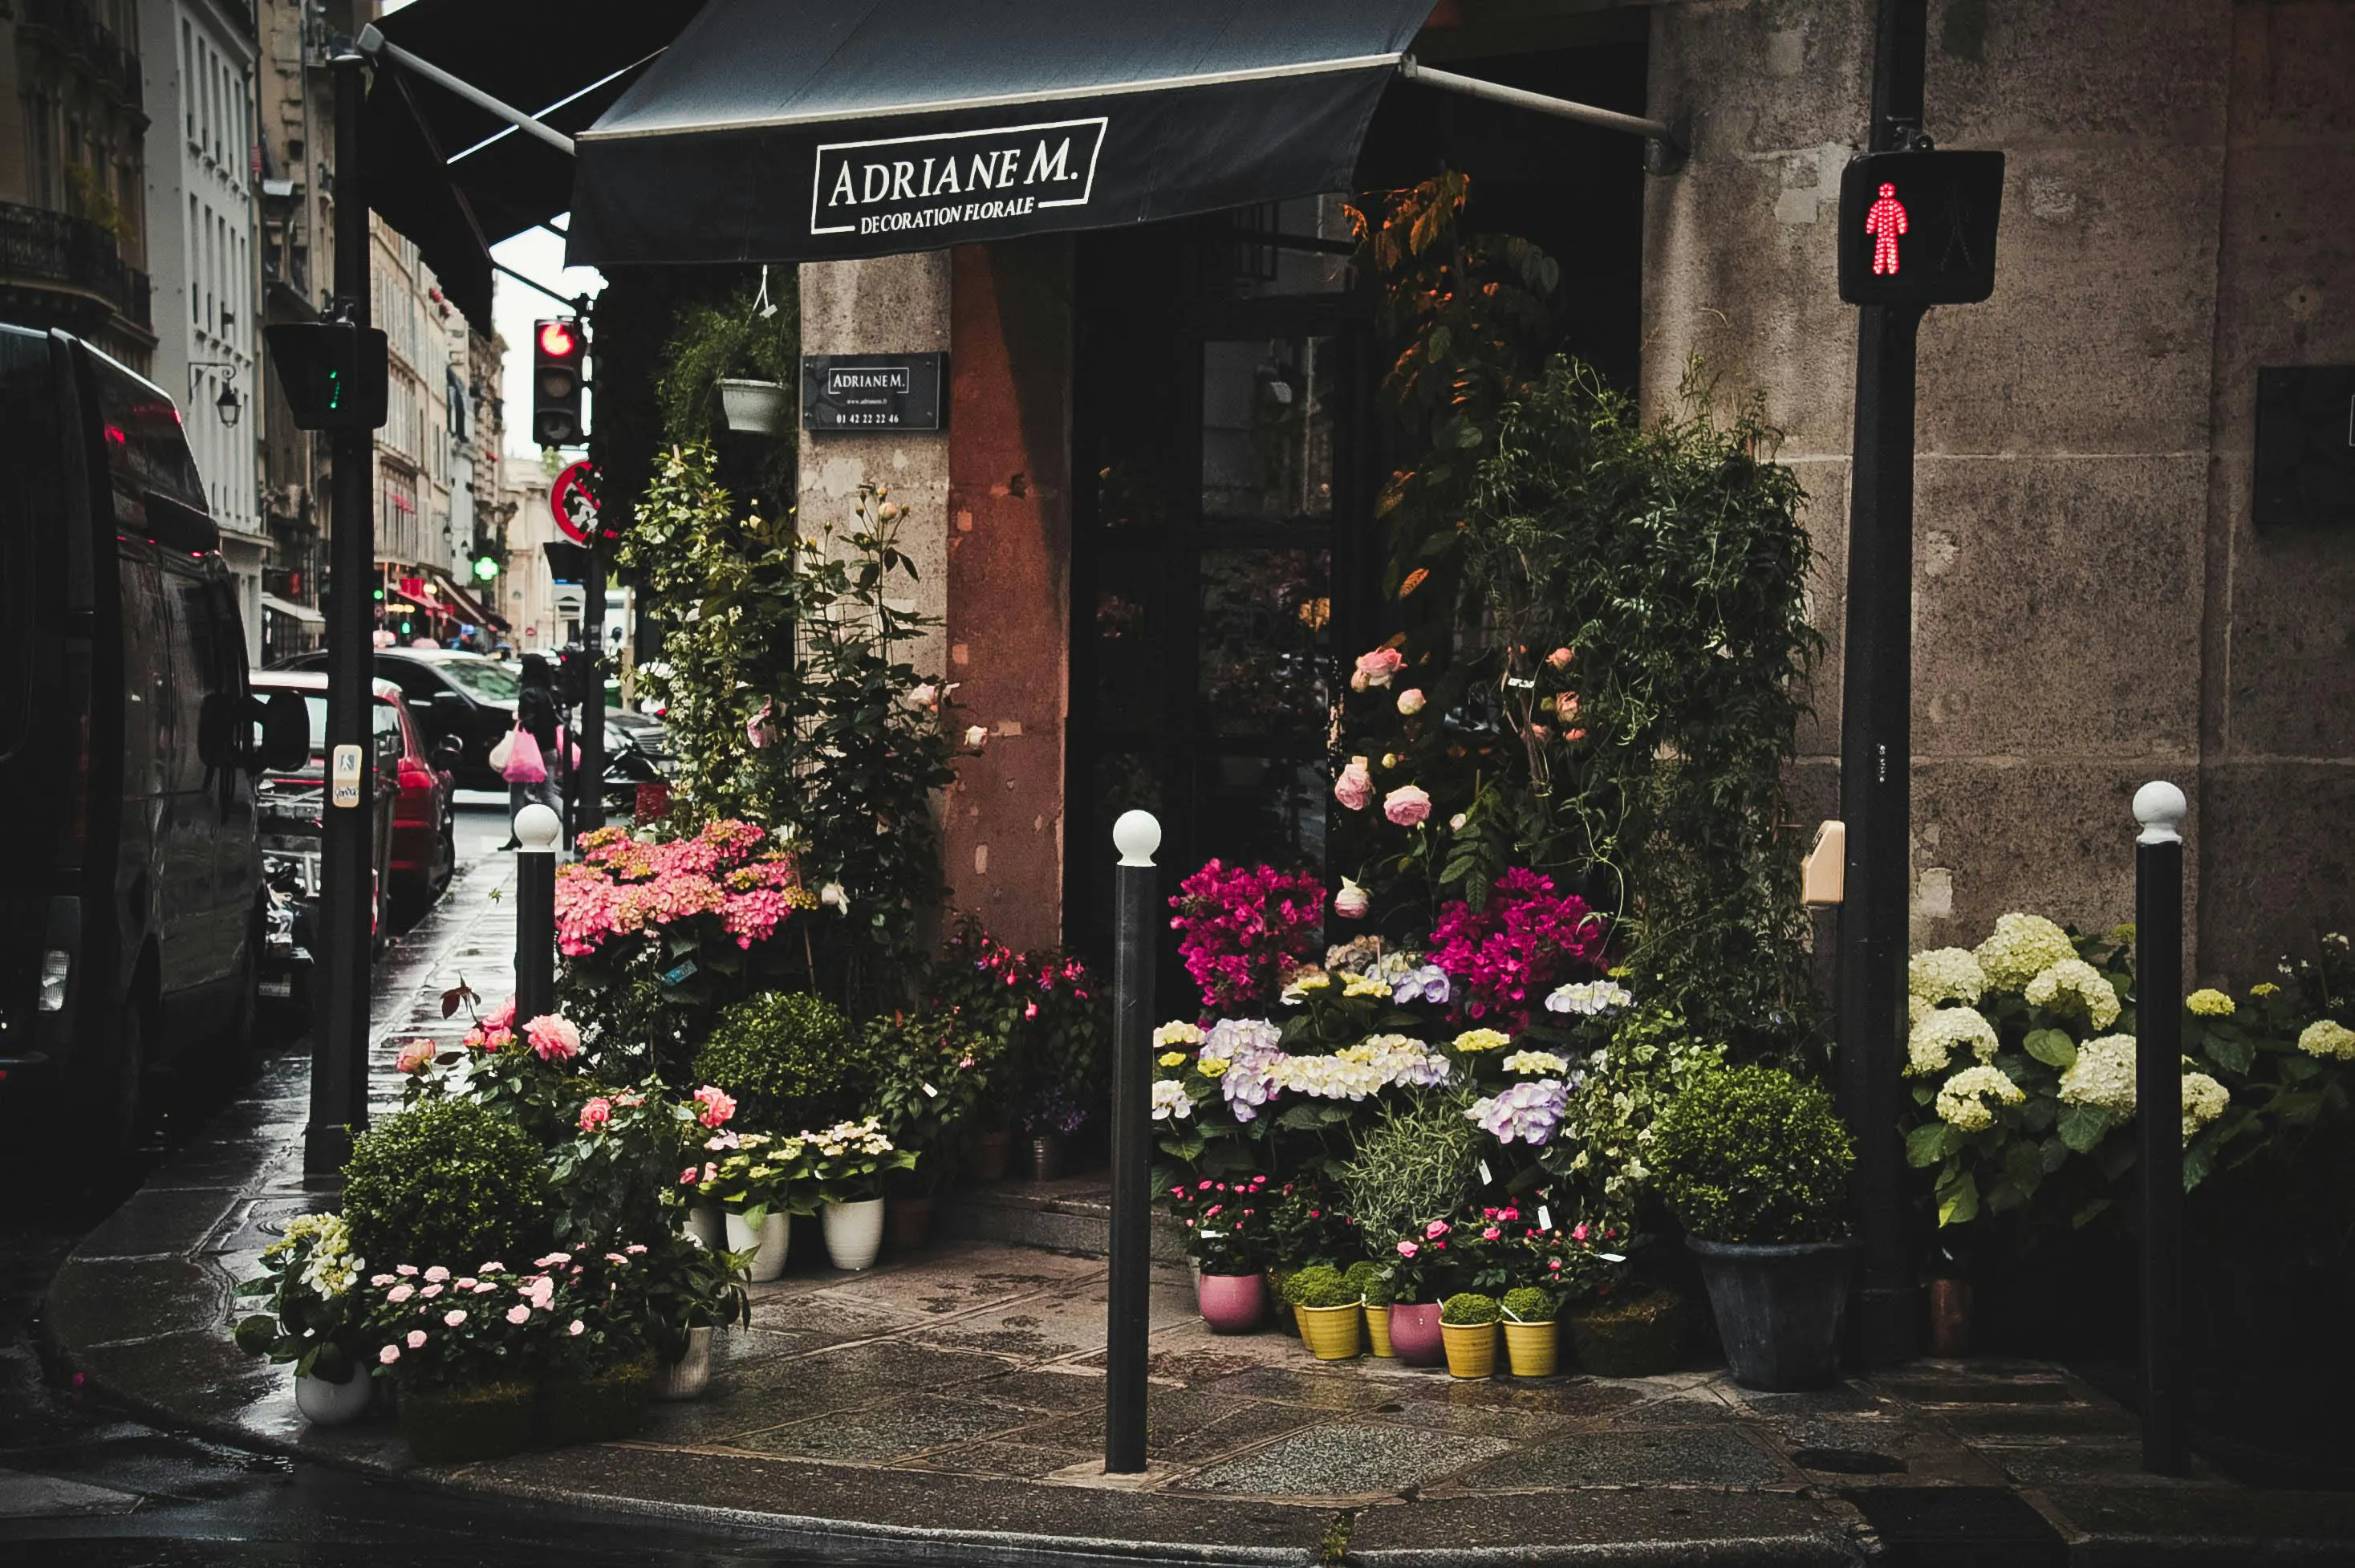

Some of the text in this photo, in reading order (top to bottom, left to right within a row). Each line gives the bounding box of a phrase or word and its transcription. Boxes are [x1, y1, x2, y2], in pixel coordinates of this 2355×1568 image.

[828, 137, 1078, 206] ADRIANE M.
[861, 197, 1035, 235] DECORATION FLORALE
[833, 373, 906, 388] ADRIANE M.
[836, 414, 899, 424] 01 42 22 22 46
